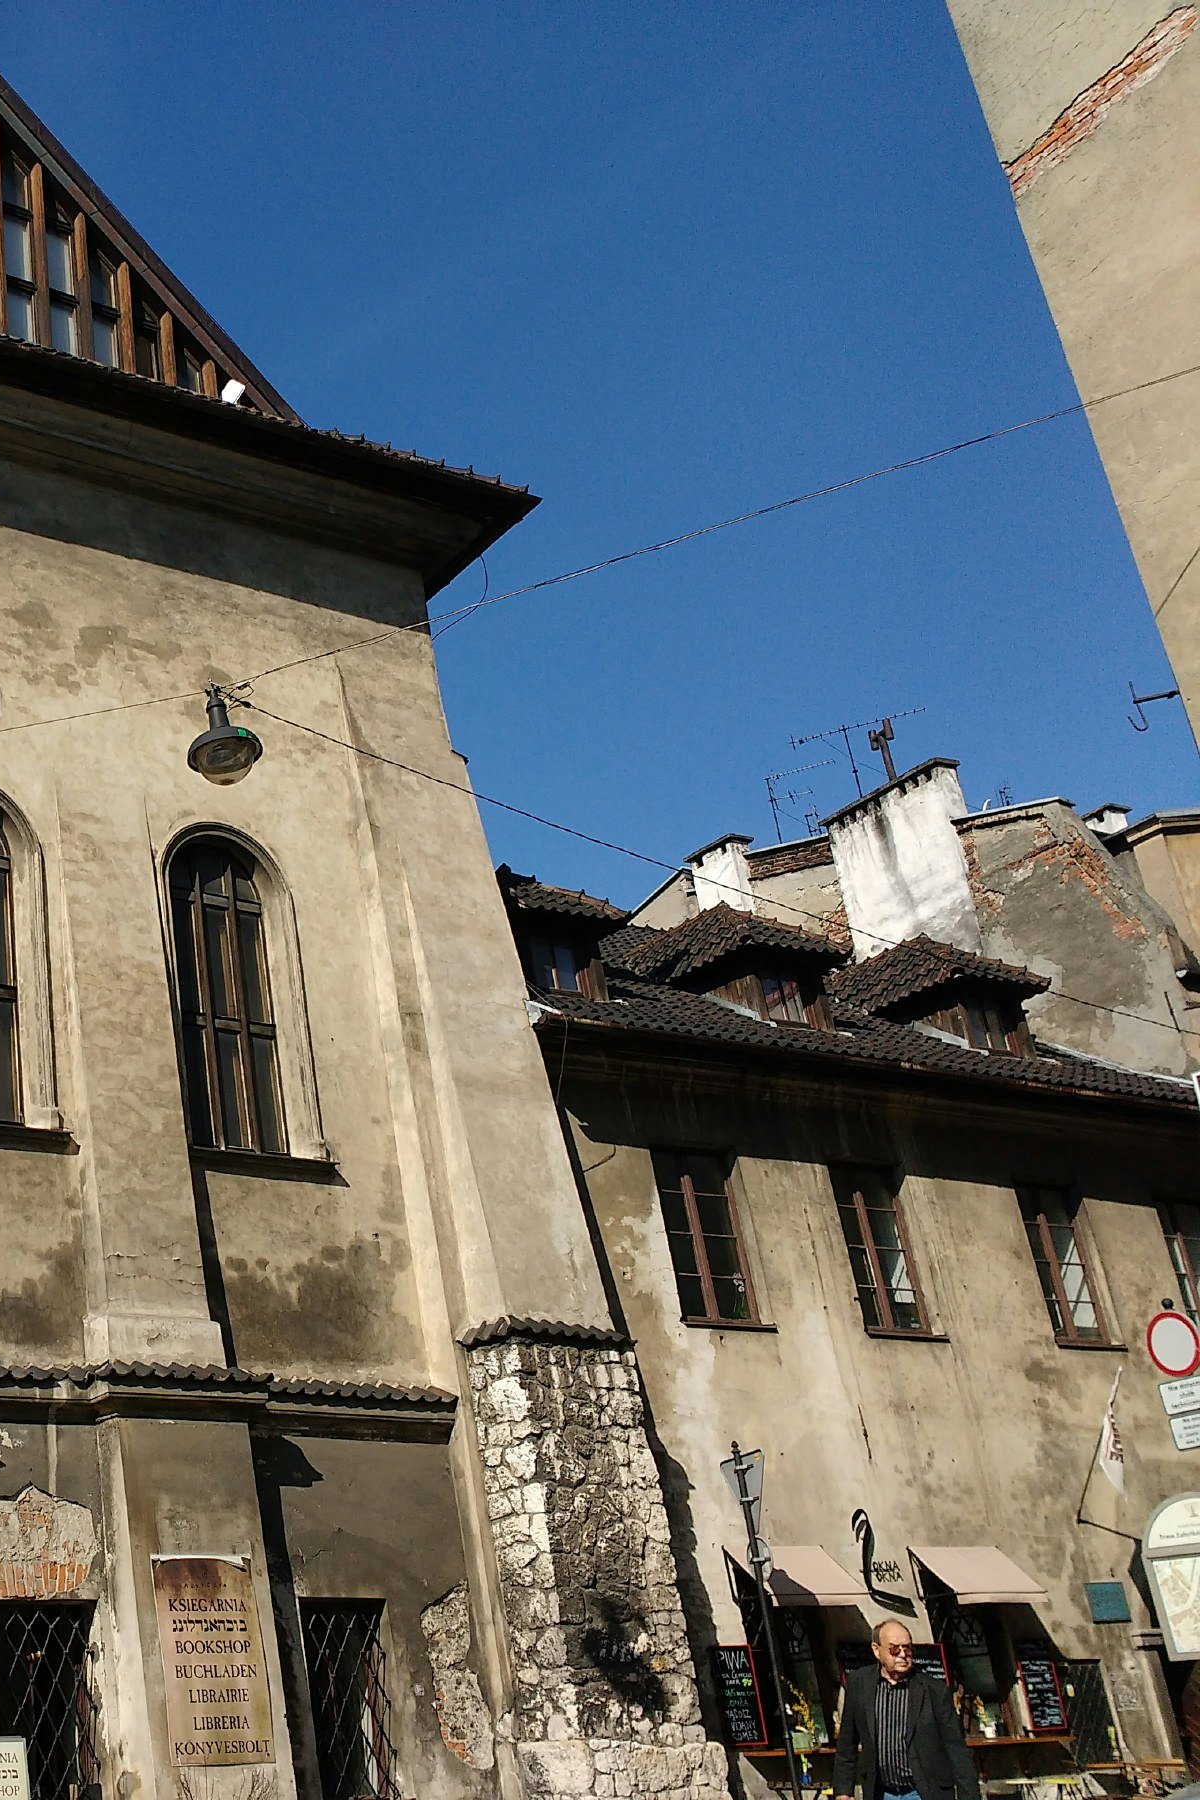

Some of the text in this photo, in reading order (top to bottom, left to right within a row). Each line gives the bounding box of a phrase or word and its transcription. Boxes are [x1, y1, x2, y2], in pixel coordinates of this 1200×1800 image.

[174, 1639, 251, 1655] BOOKSHOP
[715, 1650, 750, 1670] PIWA
[174, 1663, 258, 1679] BUCHLADEN
[188, 1688, 250, 1704] LIBRAIRIE
[192, 1715, 250, 1731] LIBRERIA
